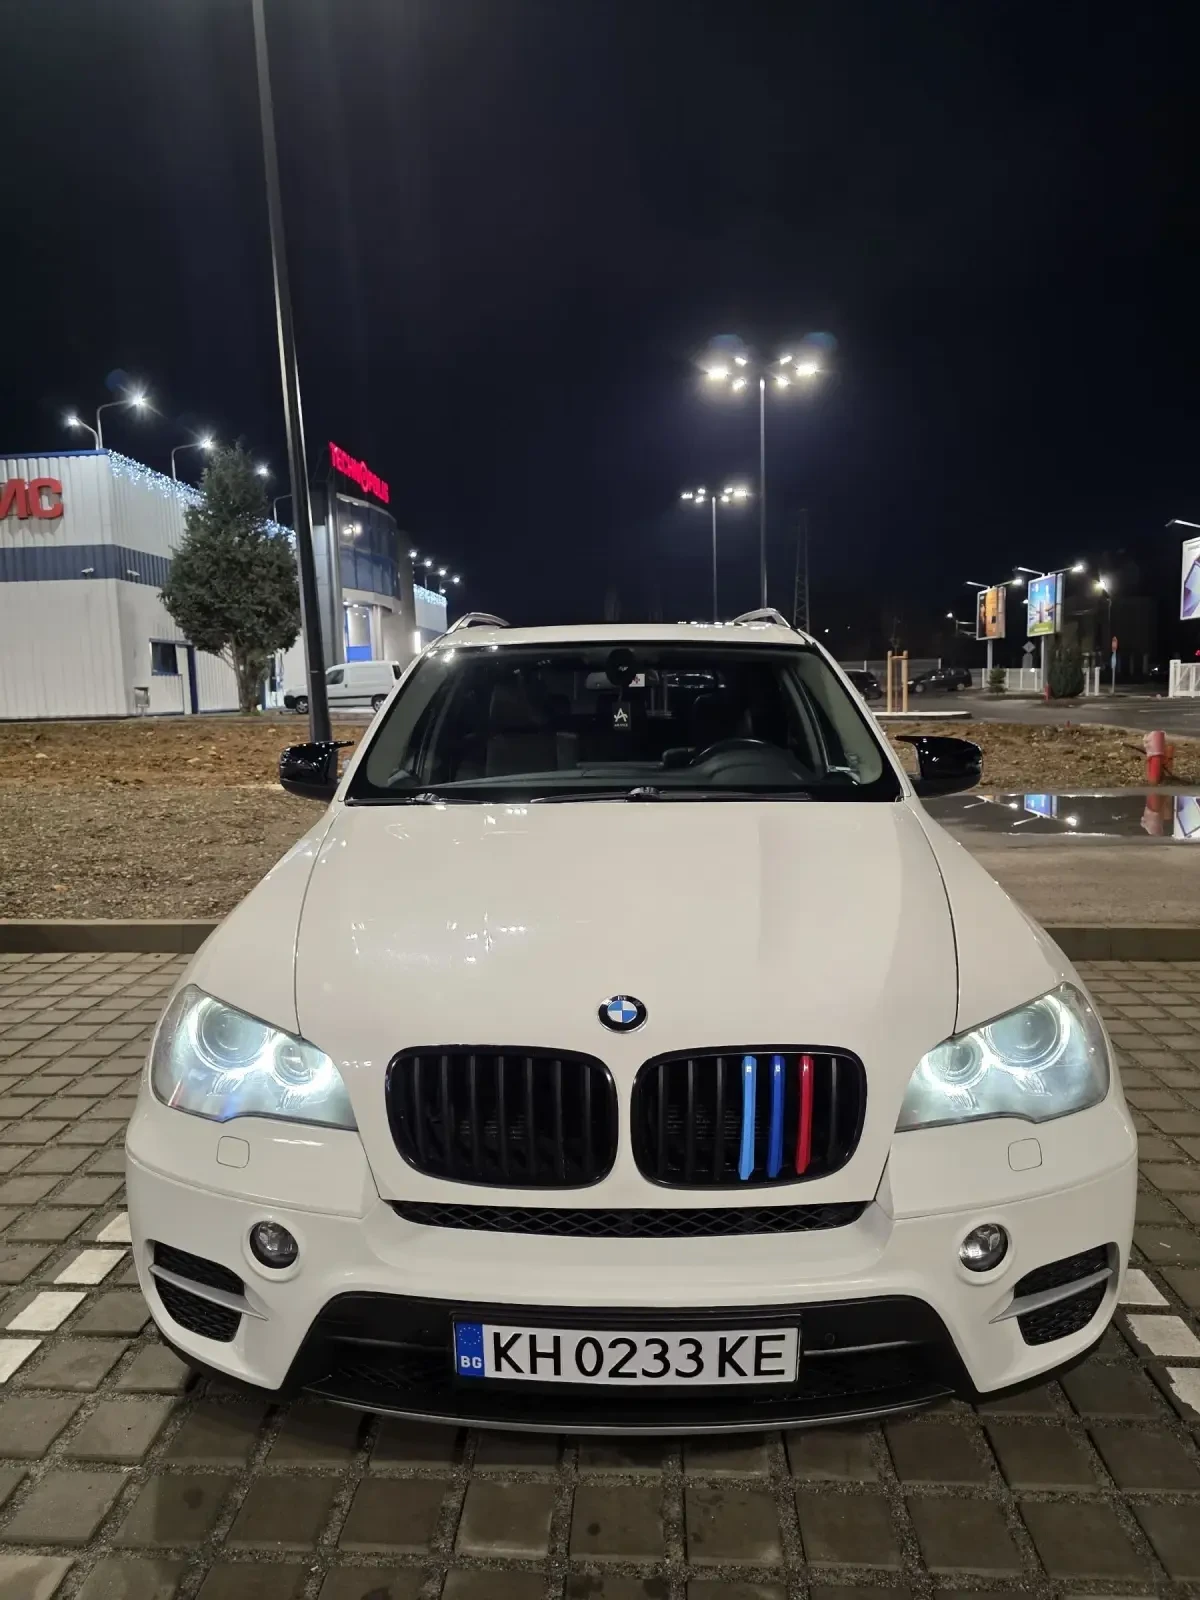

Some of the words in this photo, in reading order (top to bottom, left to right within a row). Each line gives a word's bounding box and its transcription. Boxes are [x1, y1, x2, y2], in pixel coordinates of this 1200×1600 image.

[460, 1355, 482, 1369] BG
[493, 1332, 562, 1377] KH
[575, 1336, 704, 1378] 0233
[717, 1334, 786, 1378] KE
